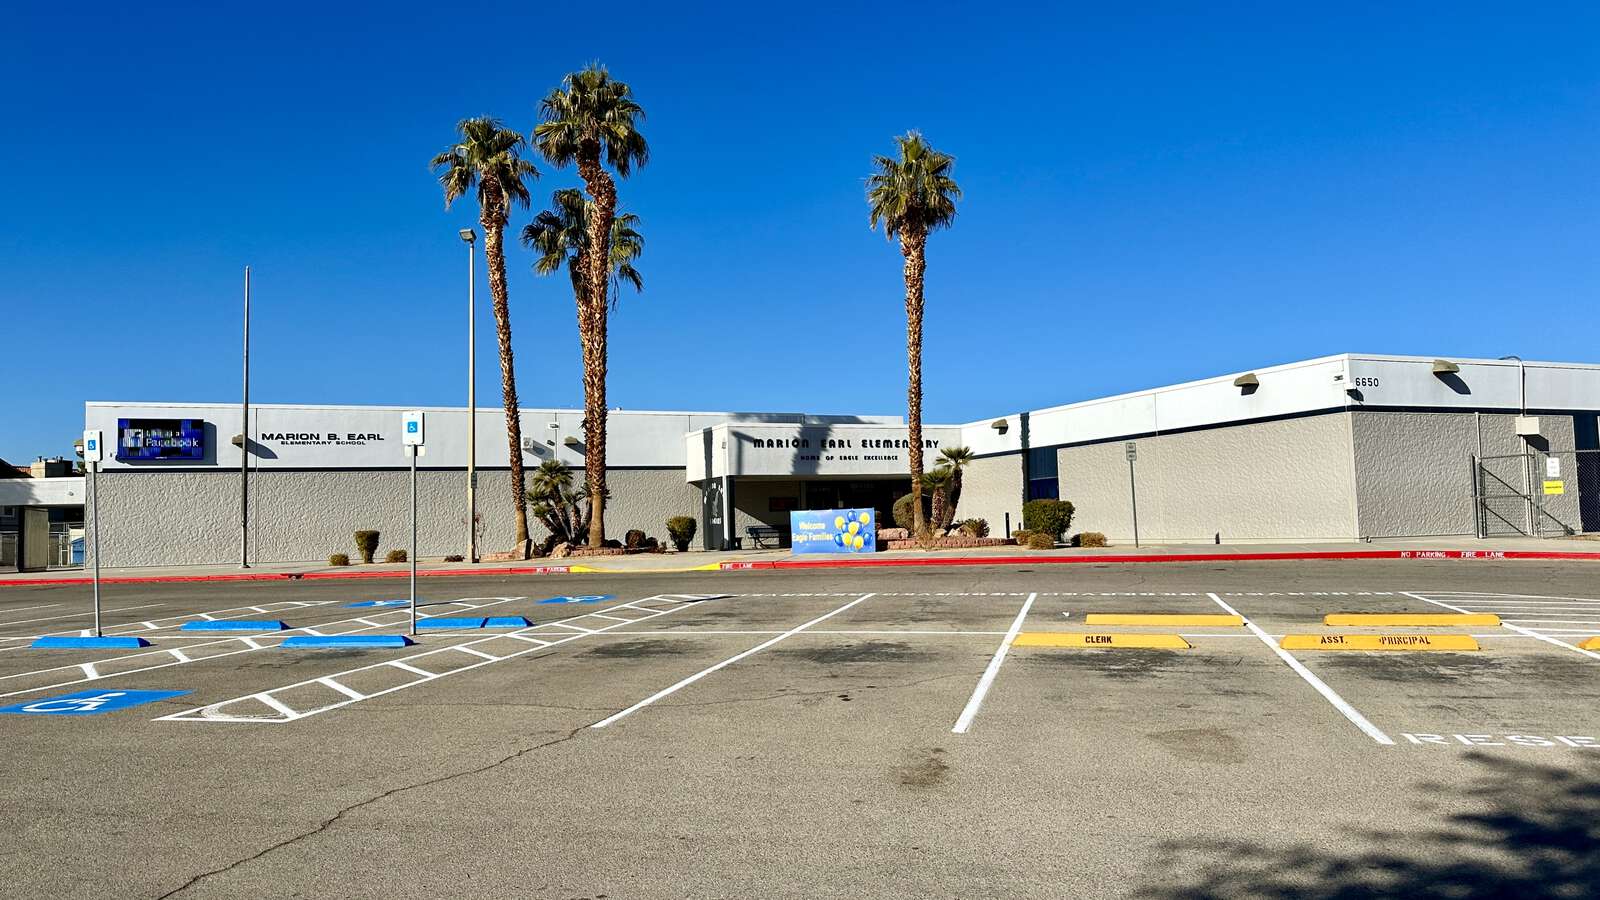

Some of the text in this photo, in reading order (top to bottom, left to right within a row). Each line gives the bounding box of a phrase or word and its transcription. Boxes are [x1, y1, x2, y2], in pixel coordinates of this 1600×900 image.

[1355, 377, 1379, 387] 6650
[261, 433, 385, 441] MARION B. EARL
[753, 438, 939, 449] MARION EARL ELEMENRY
[799, 521, 826, 530] Welcome
[808, 532, 833, 541] Families
[1085, 635, 1112, 644] CLERK
[1320, 635, 1431, 645] ASST. PRINCIPAL
